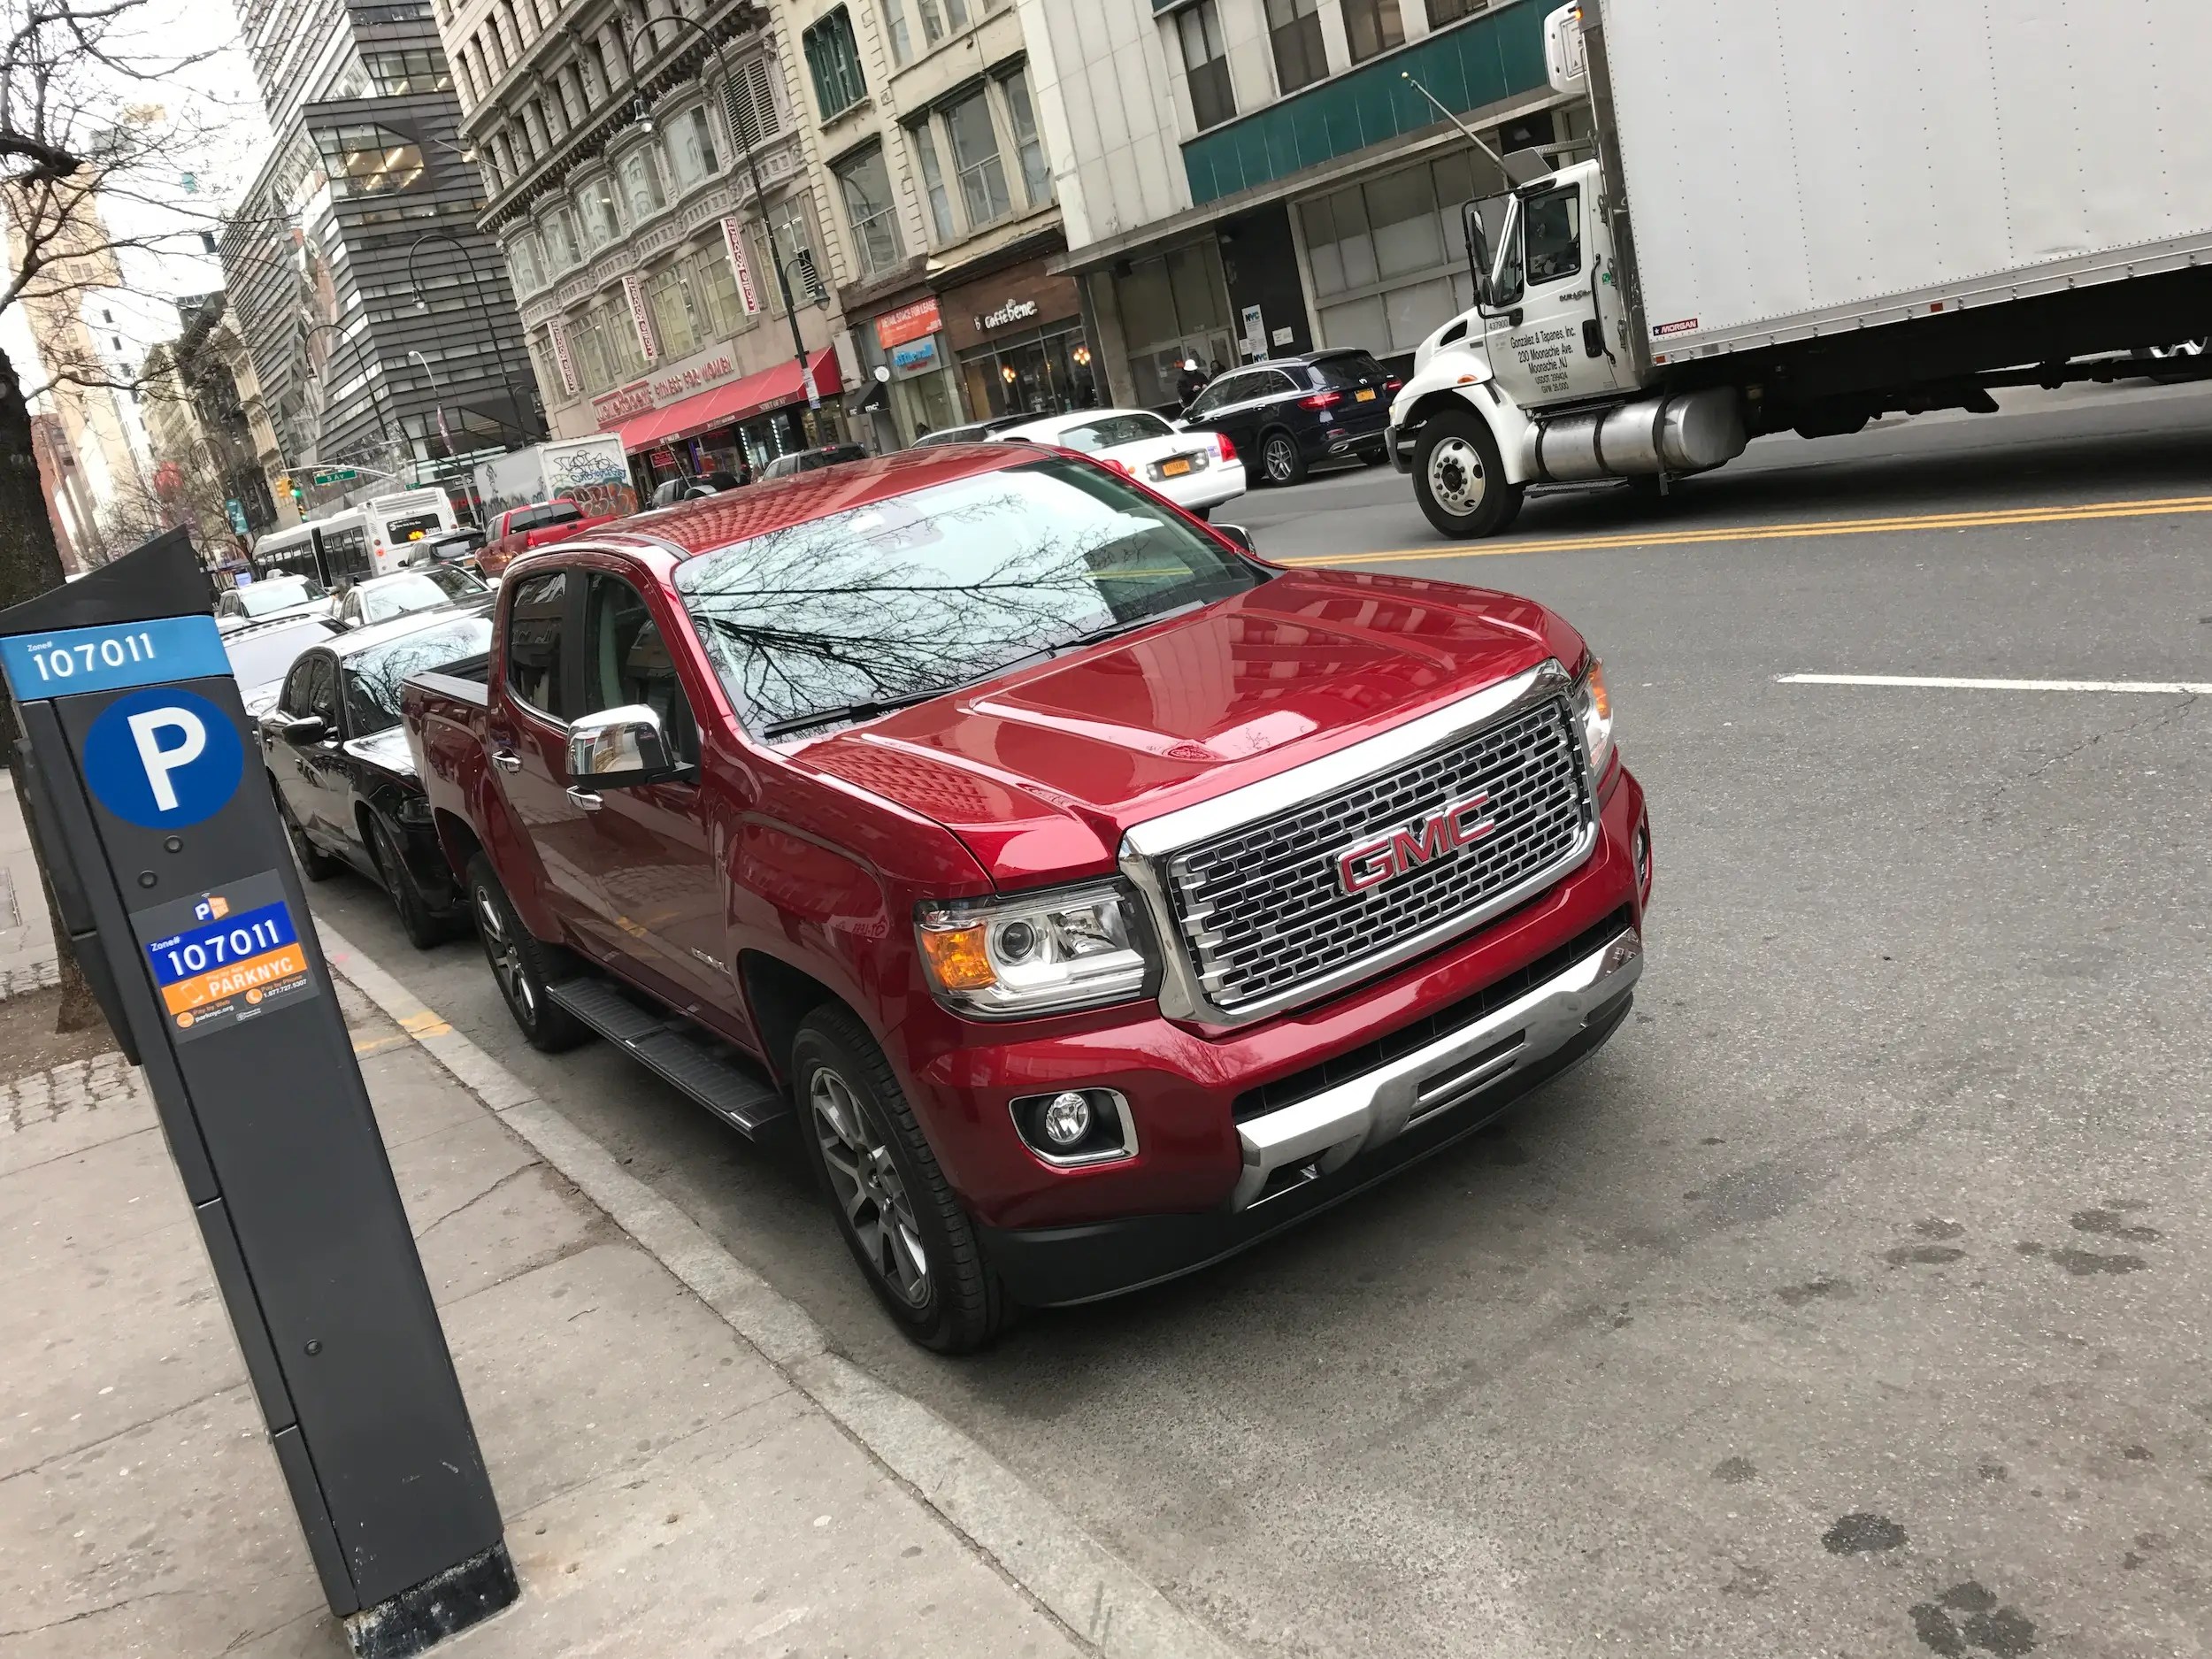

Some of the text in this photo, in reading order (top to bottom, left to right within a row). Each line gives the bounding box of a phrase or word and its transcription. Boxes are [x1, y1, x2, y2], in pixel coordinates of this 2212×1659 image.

[726, 219, 755, 311] Lucille Roberts
[626, 277, 653, 357] Lucille Roberts
[1245, 311, 1260, 322] NYC
[1661, 319, 1697, 334] MORGAN
[1510, 335, 1535, 349] Gonzalez
[1535, 332, 1540, 344] &
[1564, 326, 1577, 337] Inc.
[1517, 342, 1574, 364] 230 Moonachie Ave.
[681, 367, 702, 389] FOR
[699, 354, 733, 380] WOMEN
[1528, 357, 1558, 374] Moonachie
[27, 641, 53, 652] Zone#
[33, 633, 156, 680] 107011
[127, 707, 206, 811] P
[1337, 790, 1496, 896] GMC
[150, 935, 180, 952] Zone#
[167, 919, 280, 977] 107011
[208, 956, 293, 996] PARKNYC
[282, 974, 303, 986] Phone
[195, 1004, 234, 1023] parknyc.org
